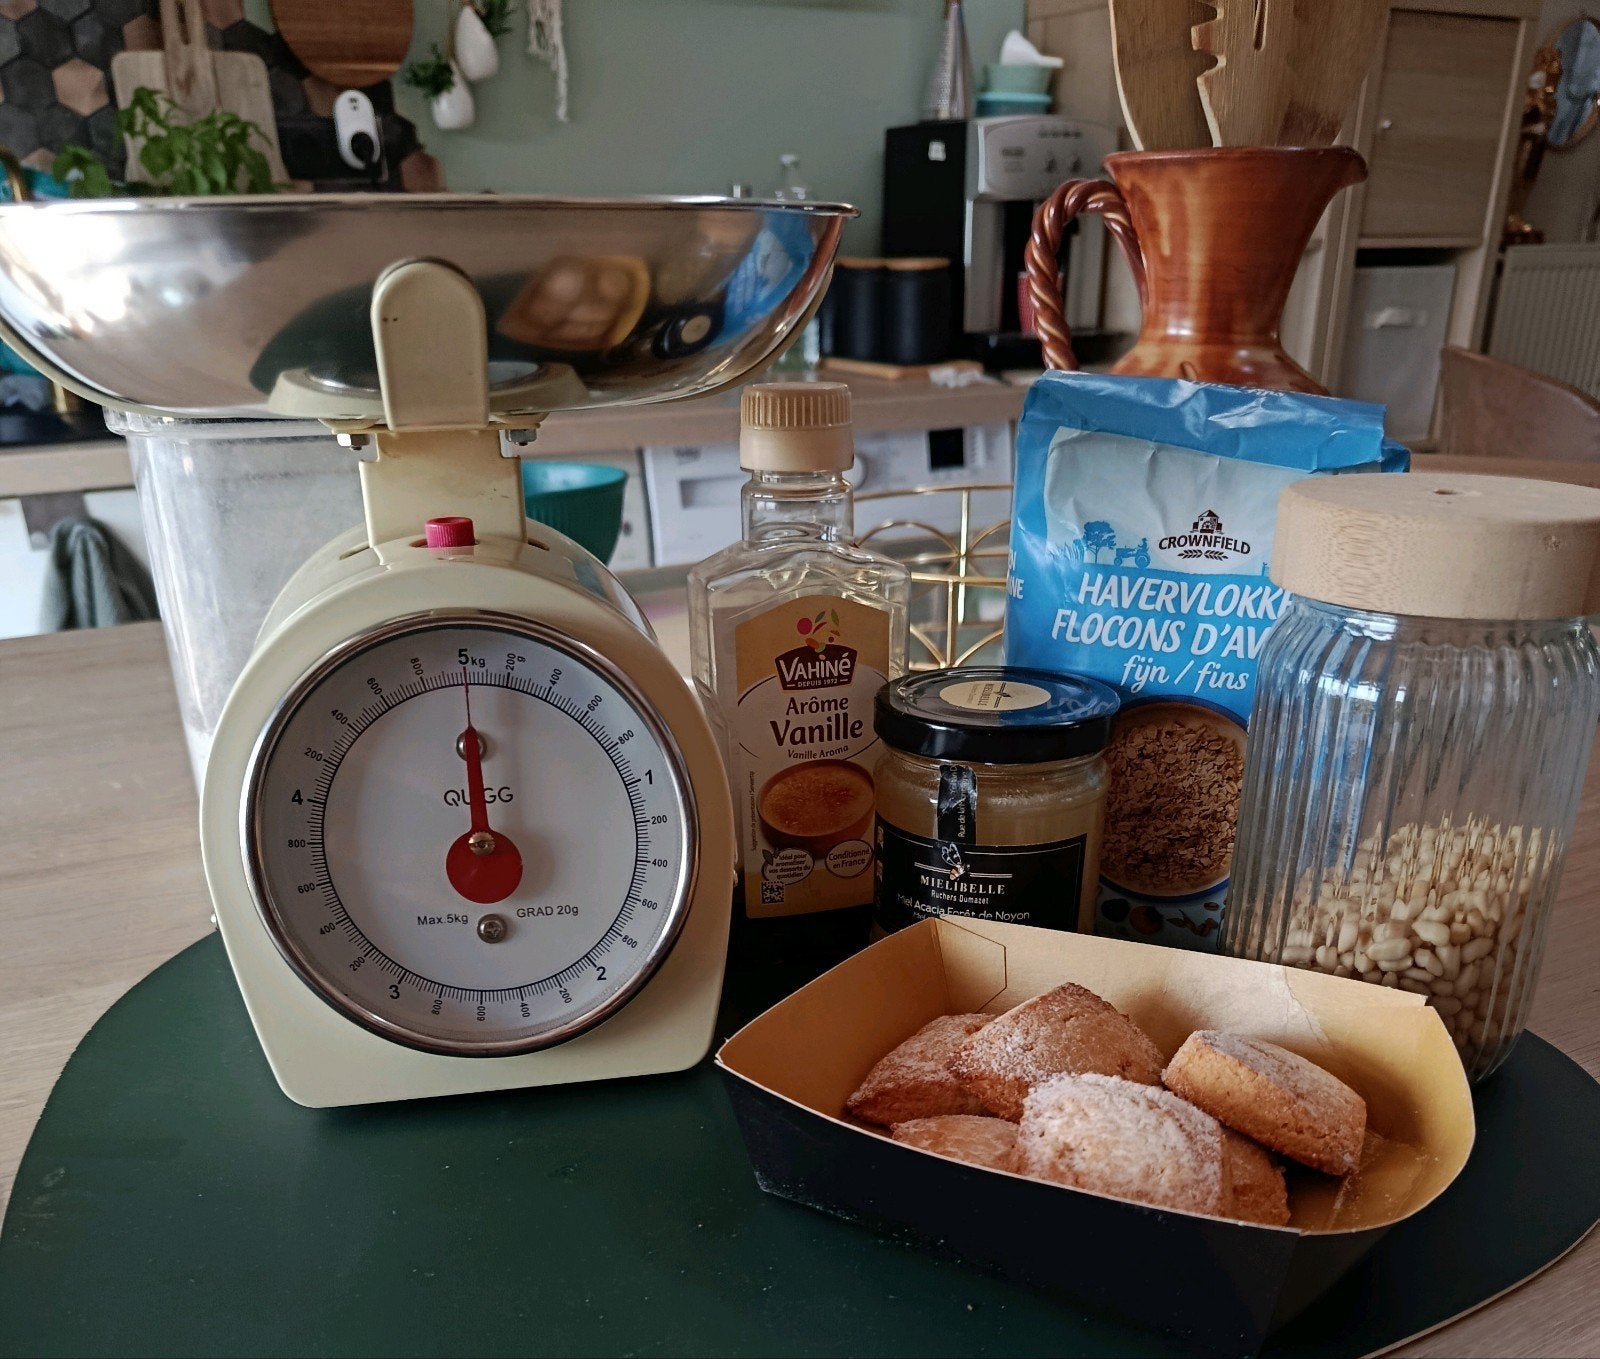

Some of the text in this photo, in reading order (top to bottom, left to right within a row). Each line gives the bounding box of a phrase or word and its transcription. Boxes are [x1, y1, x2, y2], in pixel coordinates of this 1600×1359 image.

[1158, 534, 1251, 555] CROWNFIELD
[1052, 608, 1186, 653] FLOCONS
[410, 657, 423, 676] 800
[506, 653, 516, 671] 200
[550, 668, 562, 686] 400
[797, 679, 822, 688] DEPUIS
[1193, 662, 1249, 694] fins
[366, 678, 382, 696] 600
[587, 695, 602, 712] 600
[785, 696, 849, 715] Arôme
[331, 709, 348, 724] 400
[618, 730, 634, 744] 800
[769, 712, 863, 747] Vanille
[304, 747, 322, 762] 200
[787, 744, 849, 760] Vanille Aroma
[645, 770, 653, 784] 1
[291, 789, 304, 805] 4
[444, 787, 513, 806] QUGG
[651, 815, 668, 824] 200
[958, 815, 966, 824] de
[958, 825, 966, 838] Rue
[288, 838, 306, 848] 800
[828, 848, 870, 861] Conditionné
[652, 859, 668, 868] 400
[841, 858, 866, 868] France
[298, 882, 316, 894] 600
[920, 874, 1006, 895] MIELIBELLE
[931, 889, 957, 902] Ruchers
[516, 905, 579, 918] GRAD 20g
[642, 898, 658, 911] 600
[914, 900, 945, 916] Acacia
[978, 909, 992, 920] de
[995, 911, 1030, 922] Noyon
[320, 922, 336, 936] 400
[622, 935, 638, 949] 800
[349, 956, 366, 971] 200
[596, 966, 606, 981] 2
[389, 984, 400, 1000] 3
[558, 988, 572, 1004] 200
[431, 1000, 442, 1016] 800
[476, 1006, 486, 1021] 600
[520, 1002, 530, 1018] 400
